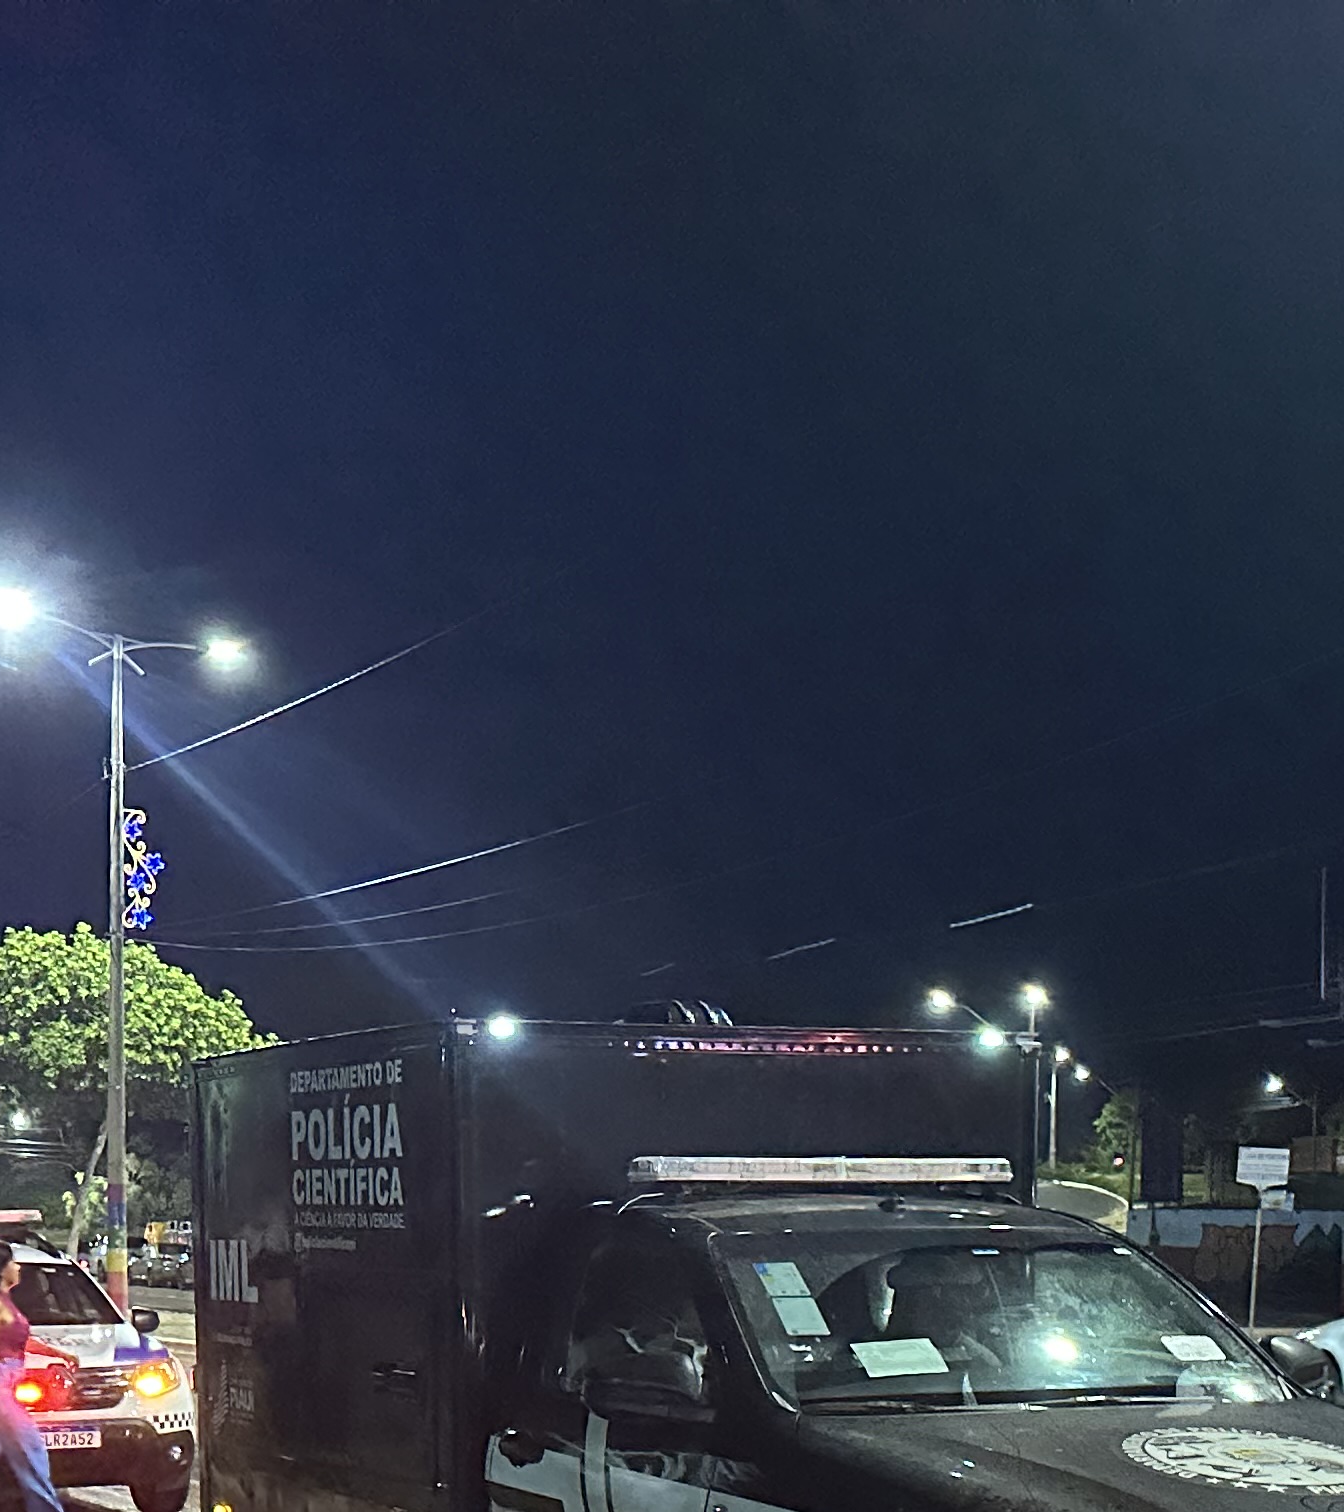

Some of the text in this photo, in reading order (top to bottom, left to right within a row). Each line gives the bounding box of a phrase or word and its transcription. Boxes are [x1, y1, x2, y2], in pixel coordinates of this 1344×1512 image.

[290, 1059, 403, 1093] DEPARTAMENTO DE
[291, 1093, 403, 1160] POLÍCIA
[292, 1159, 404, 1206] CIENTÍFICA
[209, 1239, 259, 1303] IML
[42, 1432, 94, 1447] LR2A52
